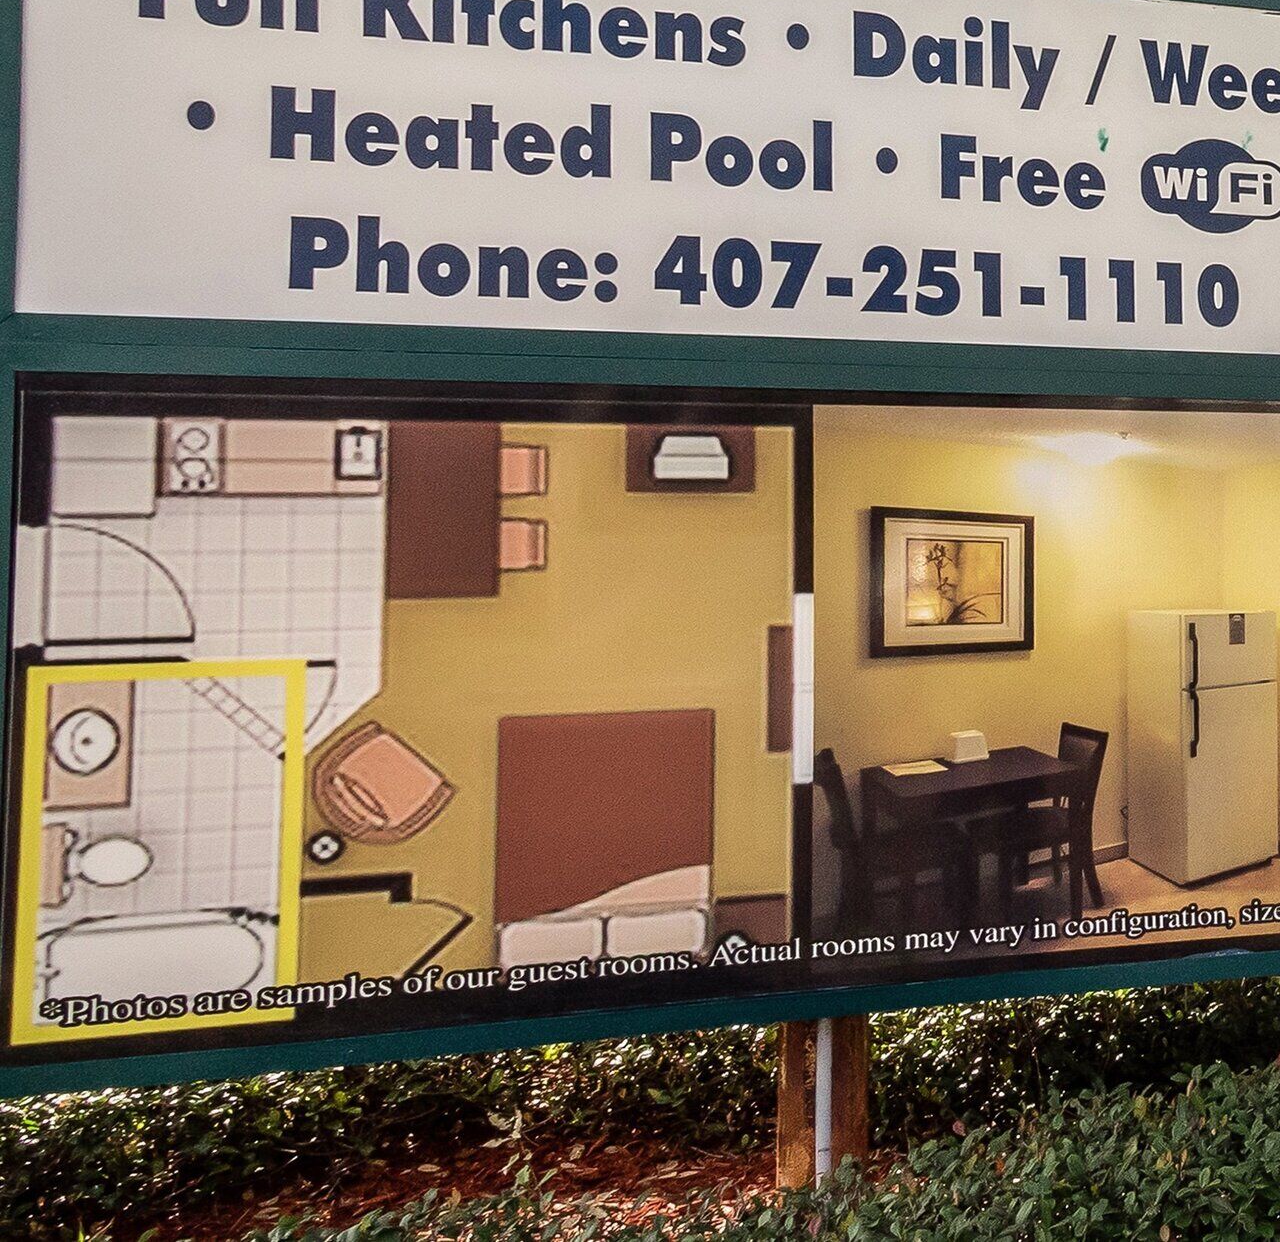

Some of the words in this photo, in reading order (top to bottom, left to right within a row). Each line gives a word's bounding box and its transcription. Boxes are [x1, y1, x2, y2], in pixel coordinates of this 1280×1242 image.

[853, 10, 1061, 111] Daily
[270, 85, 612, 179] Heated
[650, 111, 833, 192] Pool
[940, 133, 1106, 210] Free
[288, 215, 618, 303] Phone:
[654, 235, 1239, 328] 407-251-1110
[194, 989, 248, 1012] are
[260, 974, 392, 1008] samples
[403, 968, 440, 994] of
[446, 970, 498, 990] our
[508, 957, 590, 992] guest
[600, 953, 699, 978] rooms.
[709, 938, 801, 967] Actual
[811, 933, 895, 959] rooms
[904, 930, 960, 953] may
[970, 925, 1024, 947] vary
[1034, 918, 1056, 939] in
[1065, 904, 1235, 937] configuration,
